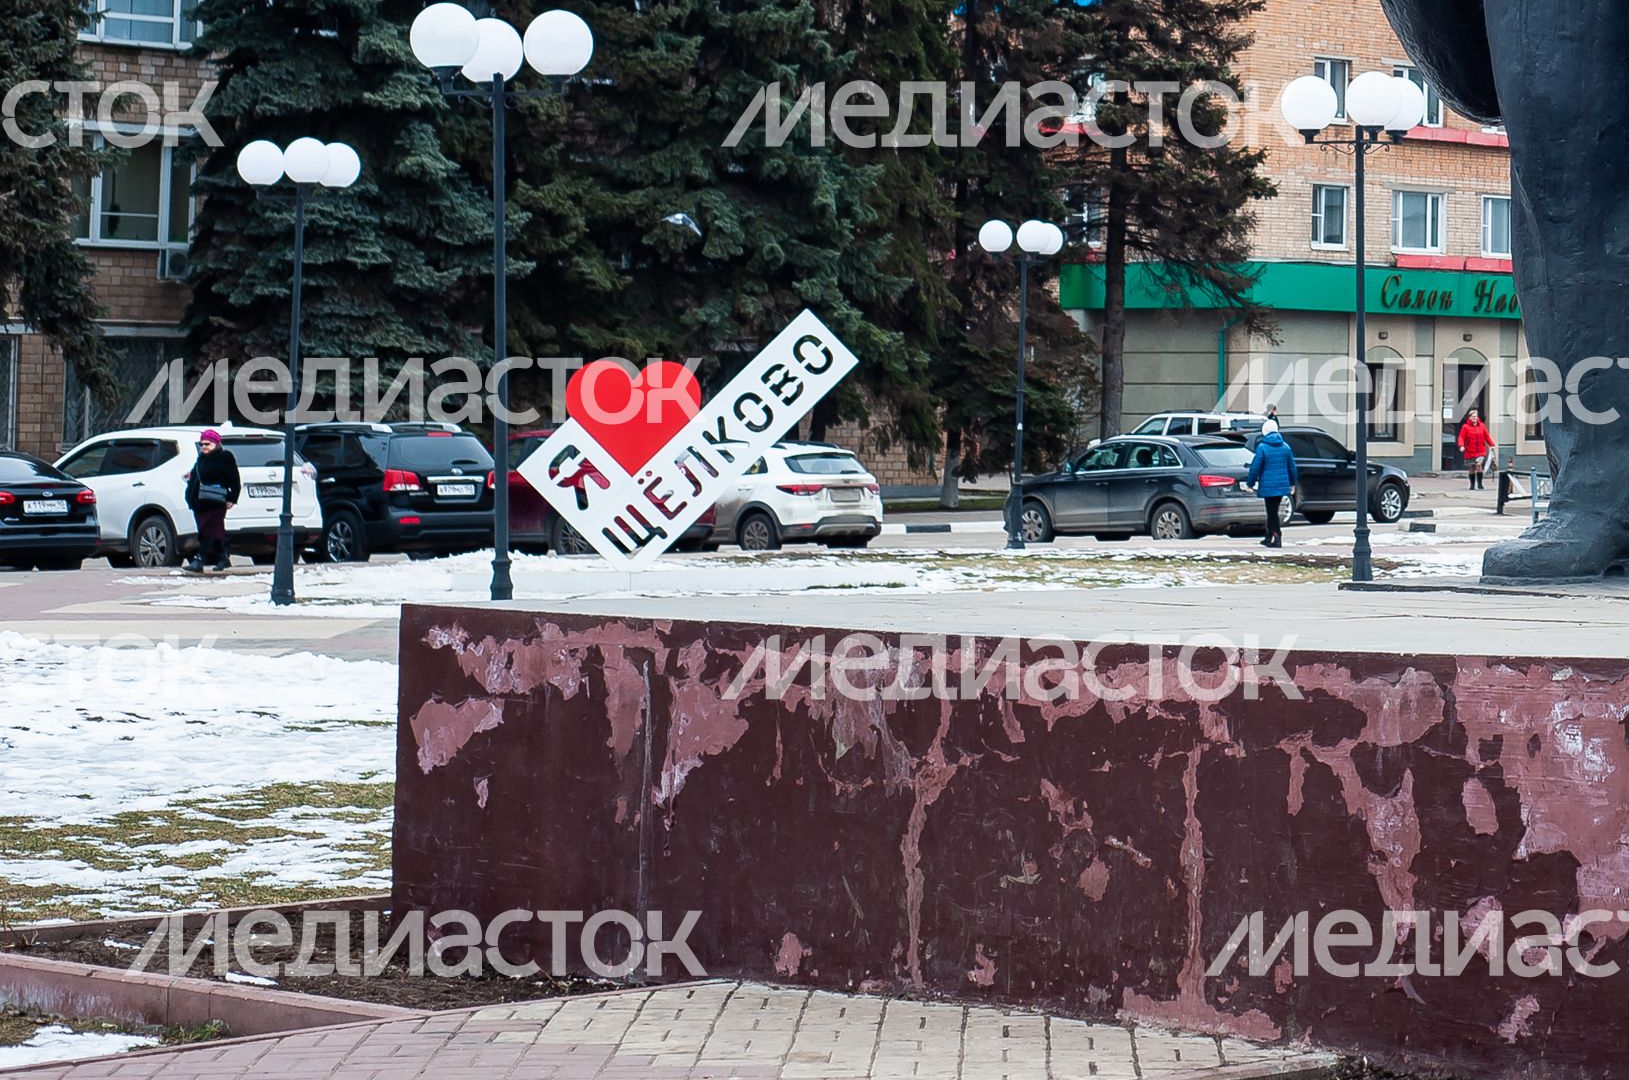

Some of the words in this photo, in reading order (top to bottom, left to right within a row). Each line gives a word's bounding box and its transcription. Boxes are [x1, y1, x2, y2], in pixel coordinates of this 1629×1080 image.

[1381, 274, 1454, 310] Салон
[547, 444, 611, 511] Я
[601, 333, 835, 556] ЩЁЛКОВО
